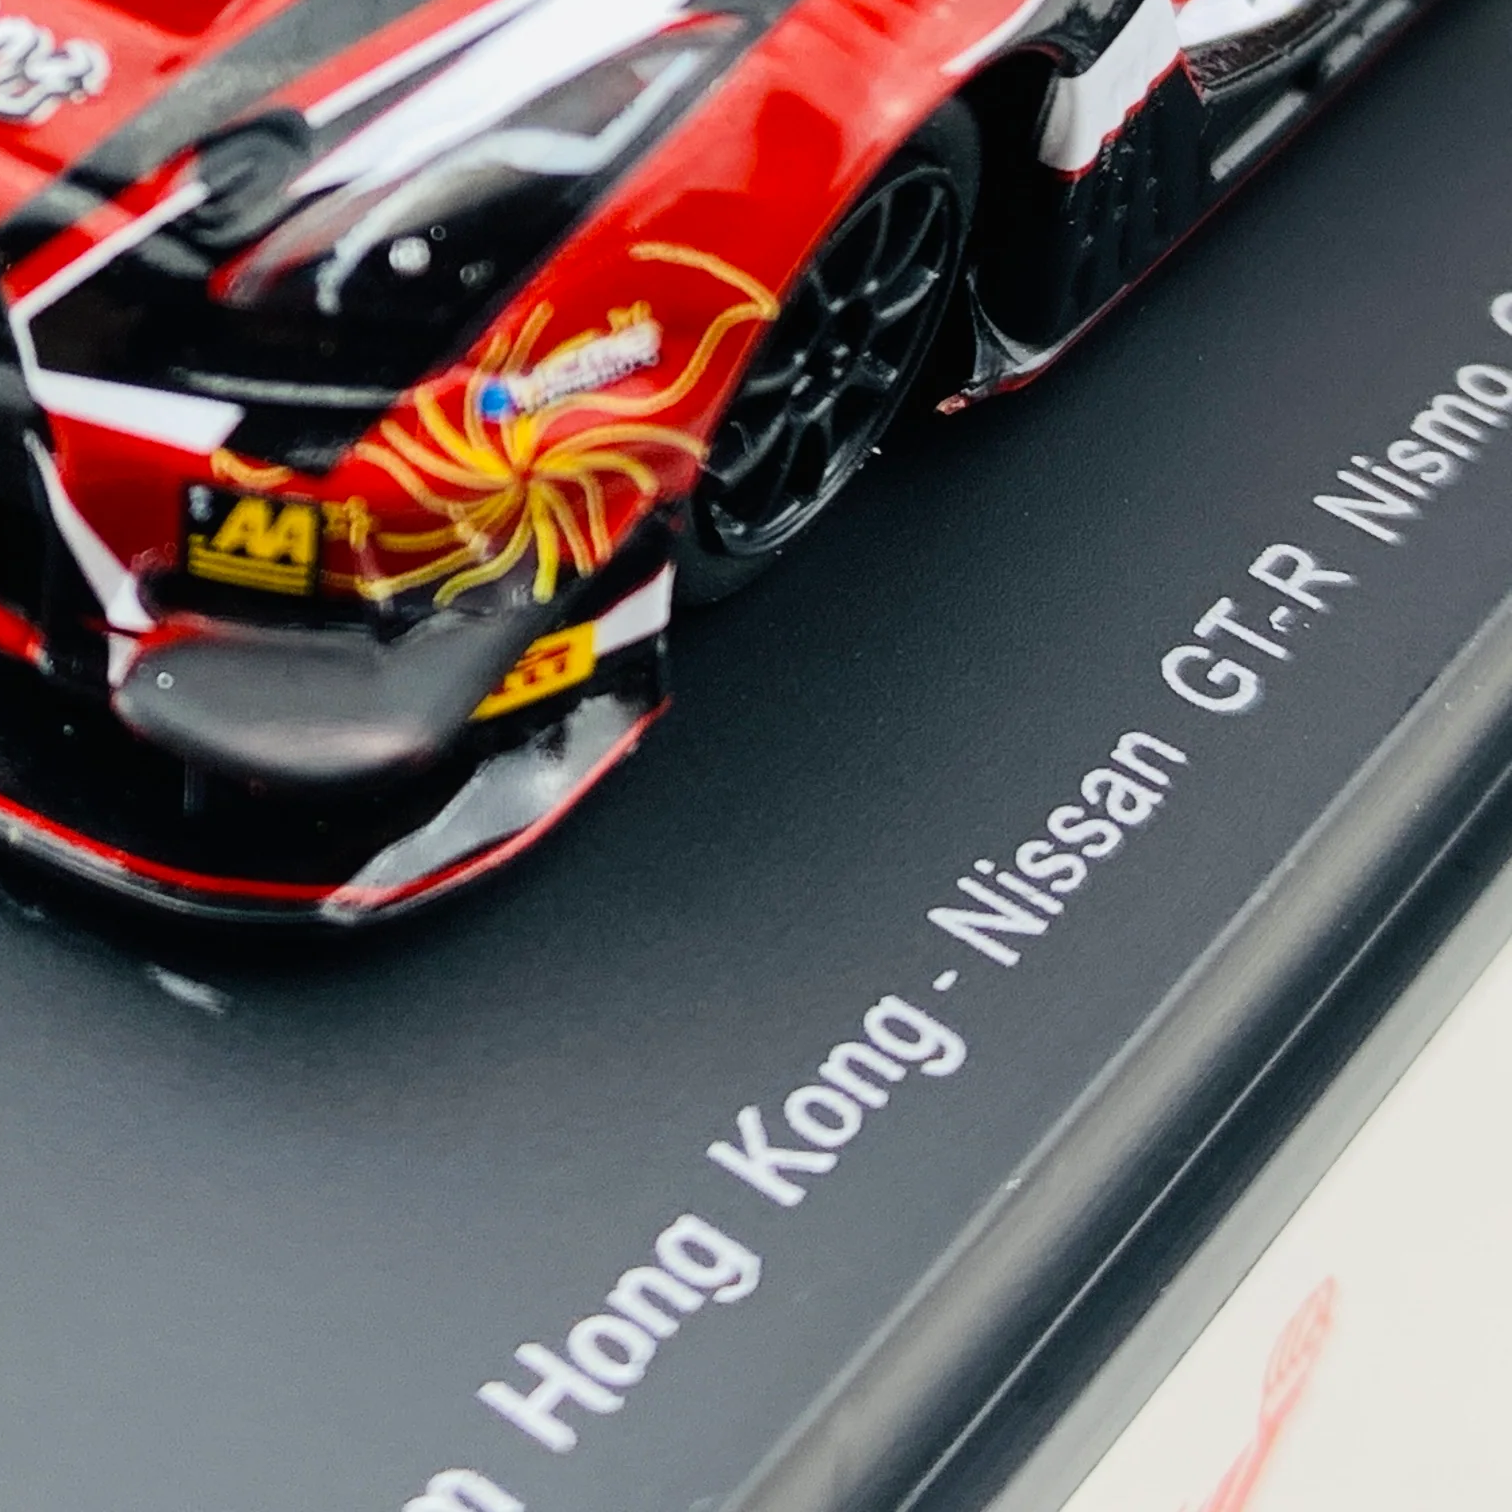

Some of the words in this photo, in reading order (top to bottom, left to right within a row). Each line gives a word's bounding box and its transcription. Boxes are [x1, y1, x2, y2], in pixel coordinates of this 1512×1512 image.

[210, 495, 314, 566] AA
[476, 1213, 763, 1453] Hong
[706, 993, 967, 1207] Kong
[926, 728, 1187, 966] Nissan
[1160, 541, 1353, 715] GT-R
[1312, 362, 1512, 544] Nismo
